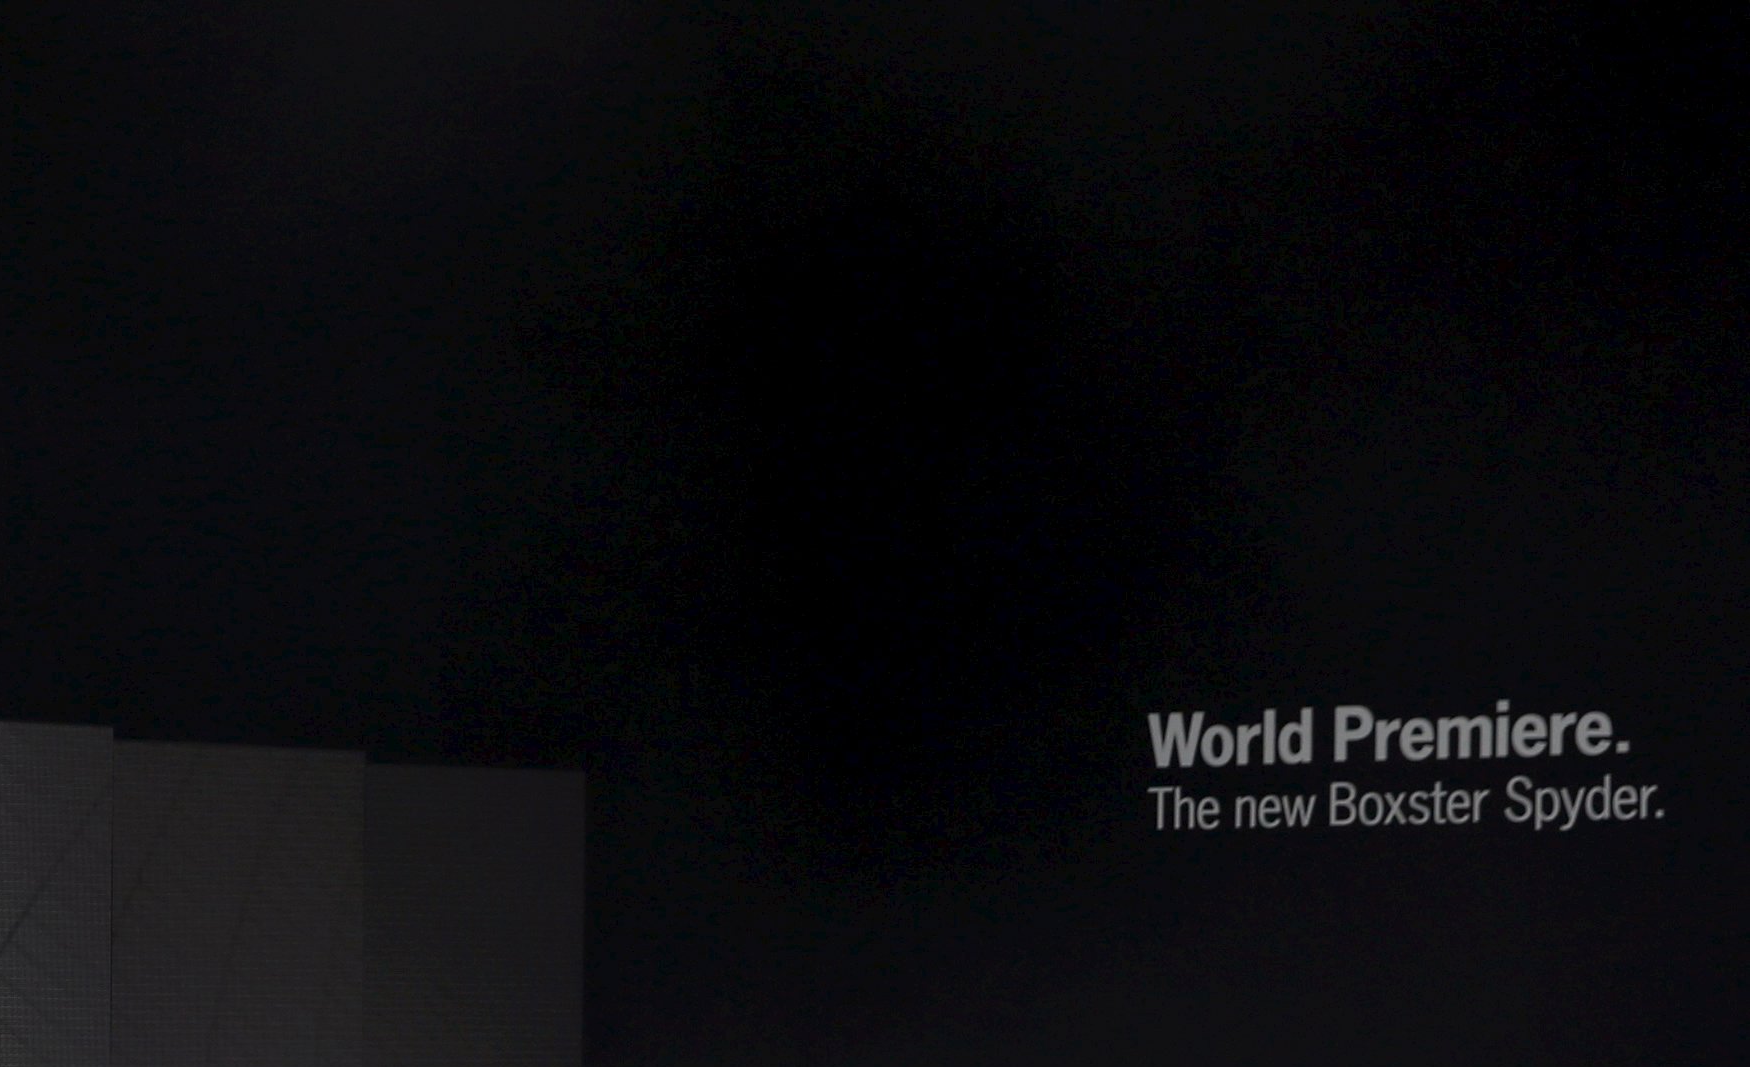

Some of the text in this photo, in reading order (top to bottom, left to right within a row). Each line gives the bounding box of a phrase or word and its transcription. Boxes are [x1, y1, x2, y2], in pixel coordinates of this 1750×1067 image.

[1147, 699, 1630, 769] World Premiere.
[1147, 773, 1665, 832] The new Boxster Spyder.
